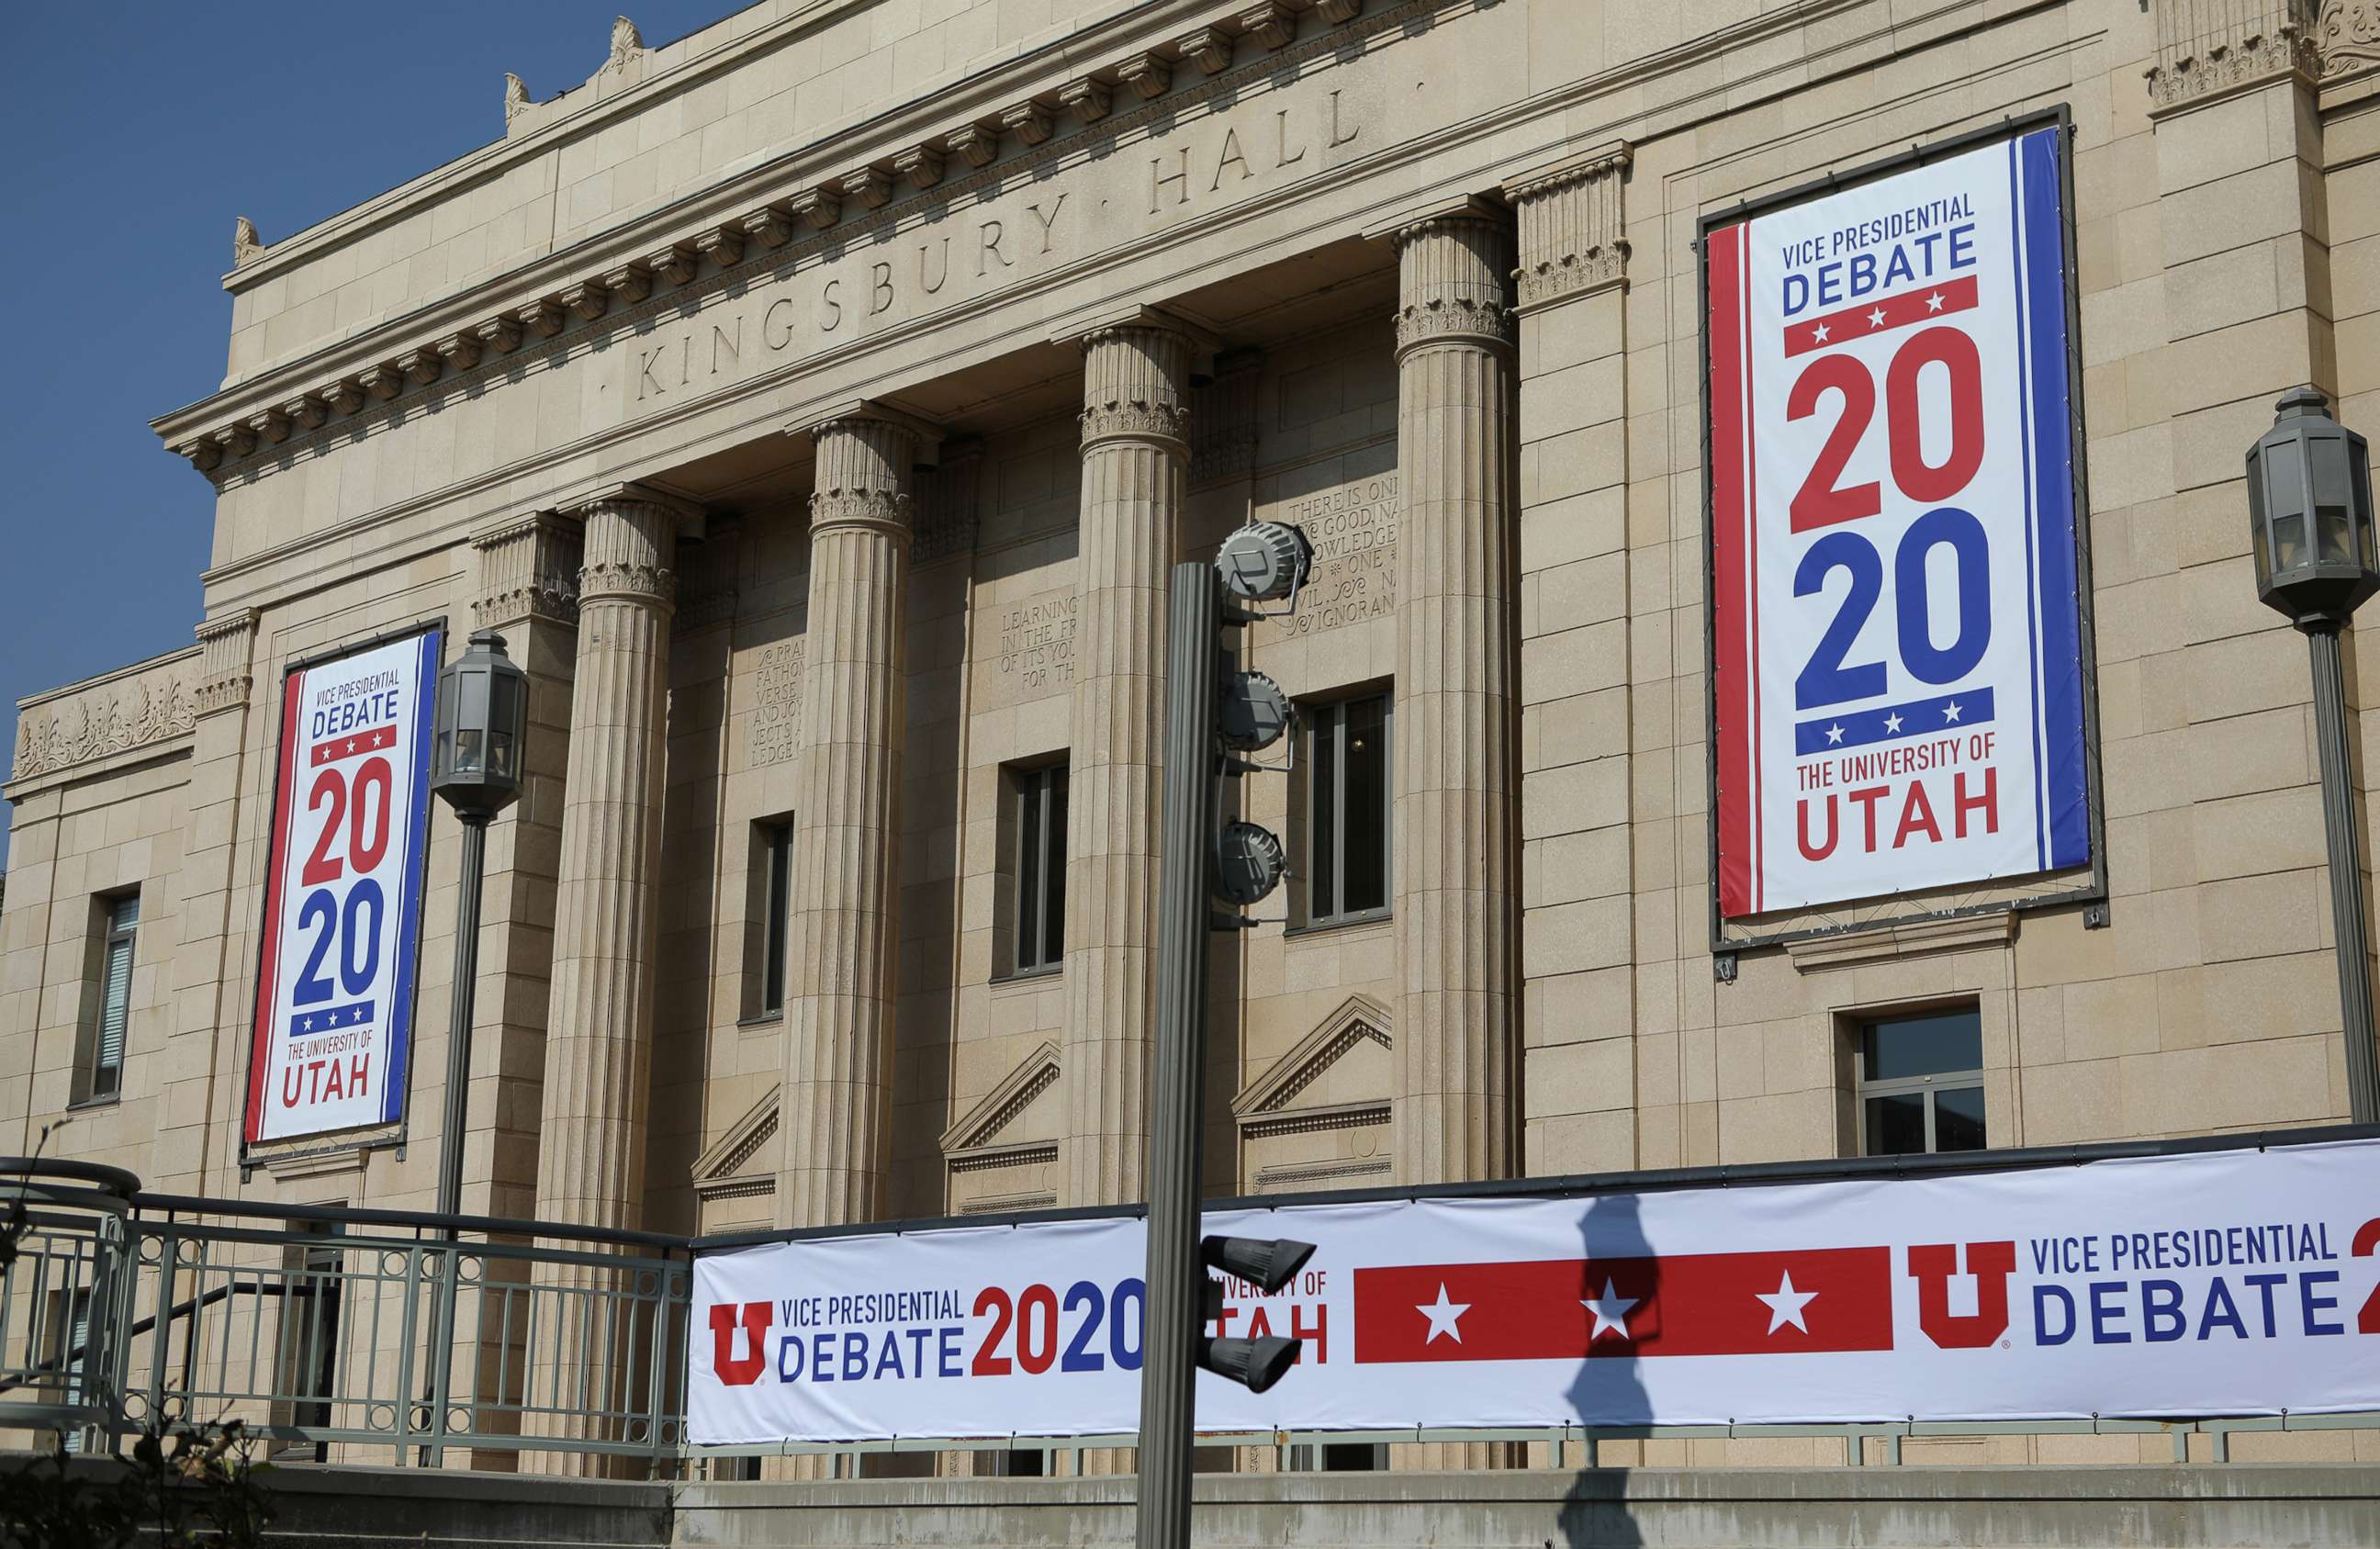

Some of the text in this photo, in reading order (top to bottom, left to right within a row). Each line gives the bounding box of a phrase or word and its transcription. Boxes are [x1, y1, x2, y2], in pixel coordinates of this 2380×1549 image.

[636, 89, 1361, 402] KINGSBURY HALL
[1781, 193, 1974, 270] VICE PRESIDENTIAL
[1783, 222, 1977, 317] DEBATE
[1786, 326, 1985, 534] 20
[1288, 493, 1344, 523] THERE
[1347, 486, 1361, 507] IS
[1314, 523, 1398, 561] OWLEDGE
[1348, 549, 1383, 574] ONE
[1002, 596, 1077, 632] LEARNING
[1317, 592, 1396, 630] IGNORAN
[1793, 507, 1992, 711] 20
[1001, 633, 1016, 654] IN
[1024, 624, 1052, 647] THE
[1001, 653, 1018, 673] OF
[1023, 647, 1045, 668] ITS
[317, 668, 399, 707] VICE PRESIDENTIAL
[756, 681, 796, 705] VERSE
[1022, 668, 1047, 690] FOR
[312, 690, 399, 739] DEBATE
[753, 705, 779, 726] AND
[1797, 731, 1996, 791] THE UNIVERSITY OF
[301, 757, 393, 887] 20
[1796, 767, 2000, 862] UTAH
[293, 878, 385, 1007] 20
[288, 1029, 373, 1061] THE UNIVERSITY OF
[282, 1052, 370, 1109] UTAH
[2031, 1222, 2338, 1274] VICE PRESIDENTIAL
[781, 1288, 964, 1328] VICE PRESIDENTIAL
[1305, 1271, 1327, 1296] OF
[1907, 1240, 2016, 1349] U
[2033, 1270, 2345, 1346] DEBATE
[709, 1300, 773, 1386] U
[778, 1277, 1145, 1384] DEBATE 2020
[1217, 1304, 1328, 1364] TAH
